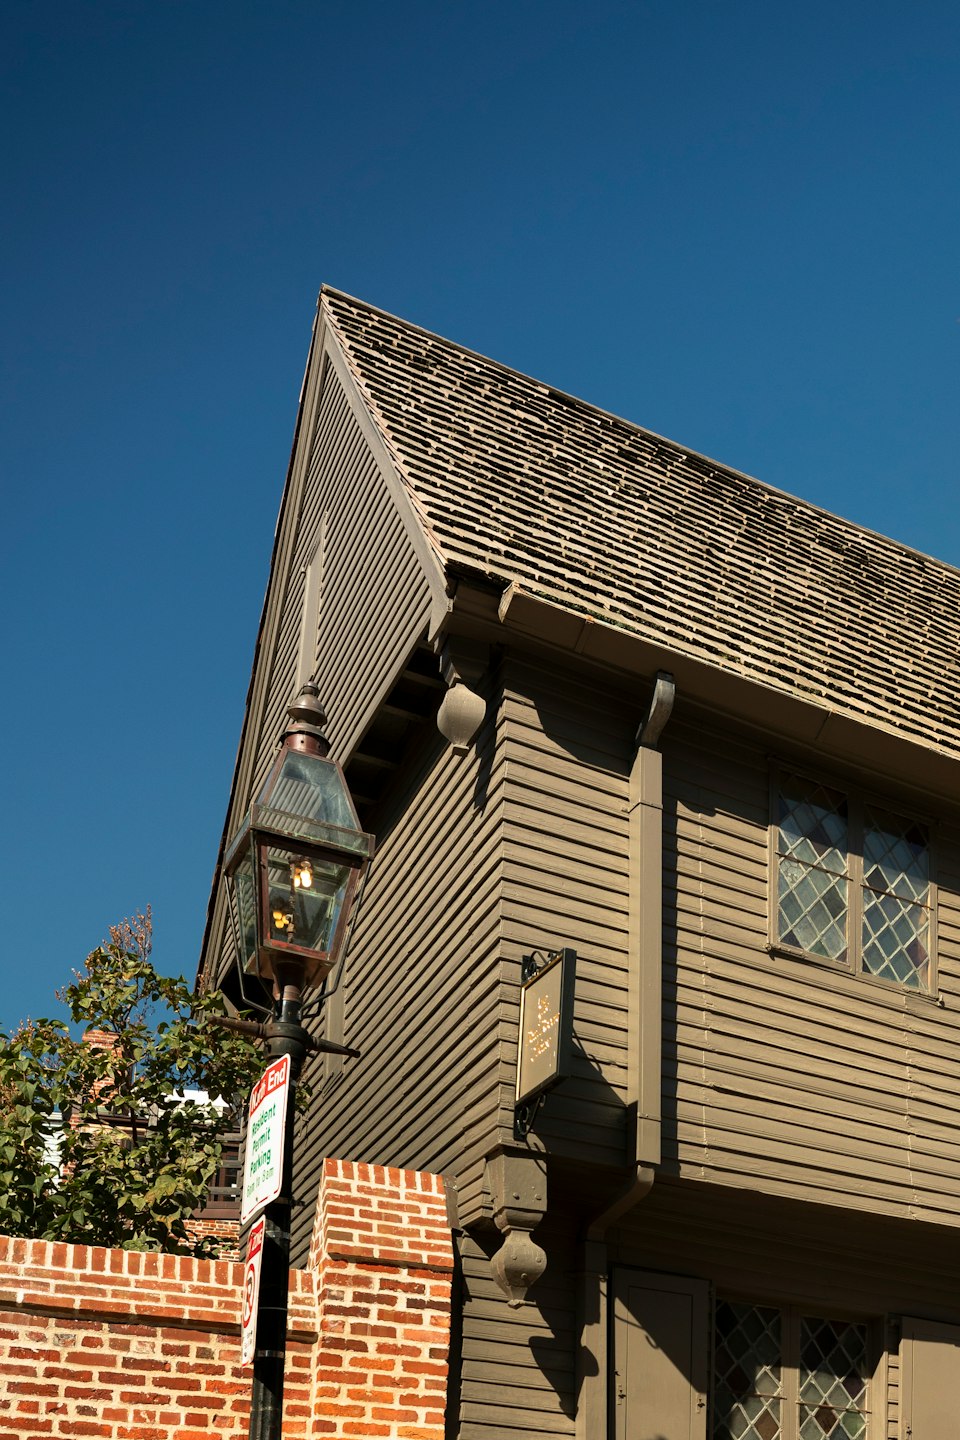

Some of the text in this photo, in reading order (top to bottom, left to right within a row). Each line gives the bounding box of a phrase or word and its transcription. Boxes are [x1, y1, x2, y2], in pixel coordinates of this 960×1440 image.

[267, 1061, 287, 1092] End
[251, 1103, 276, 1137] Resident
[252, 1127, 271, 1156] Permit
[250, 1148, 271, 1177] Parking
